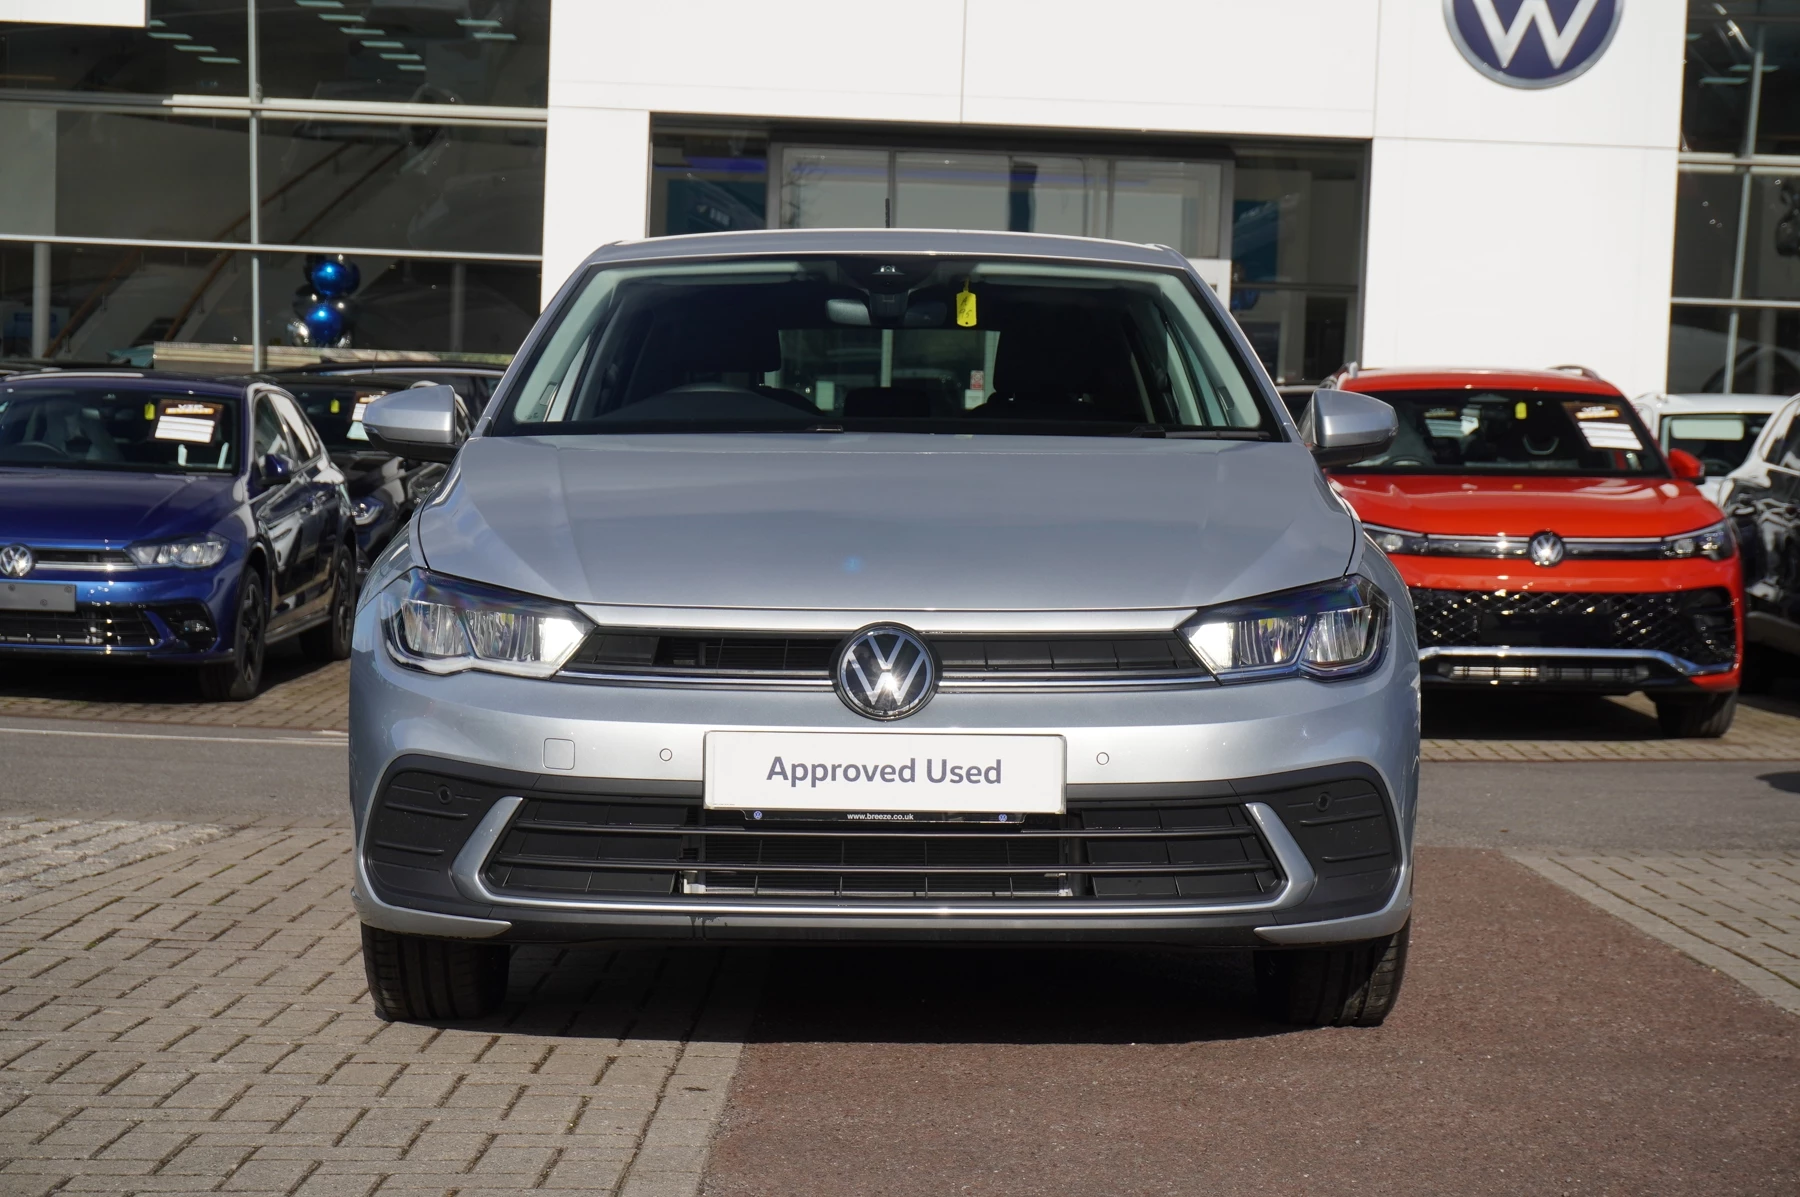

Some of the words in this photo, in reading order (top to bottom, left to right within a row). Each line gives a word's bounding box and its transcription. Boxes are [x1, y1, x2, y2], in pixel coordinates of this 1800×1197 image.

[841, 627, 932, 715] VW
[766, 756, 916, 788] Approved
[926, 758, 1002, 784] Used
[846, 812, 914, 820] www.breeze.co.uk
